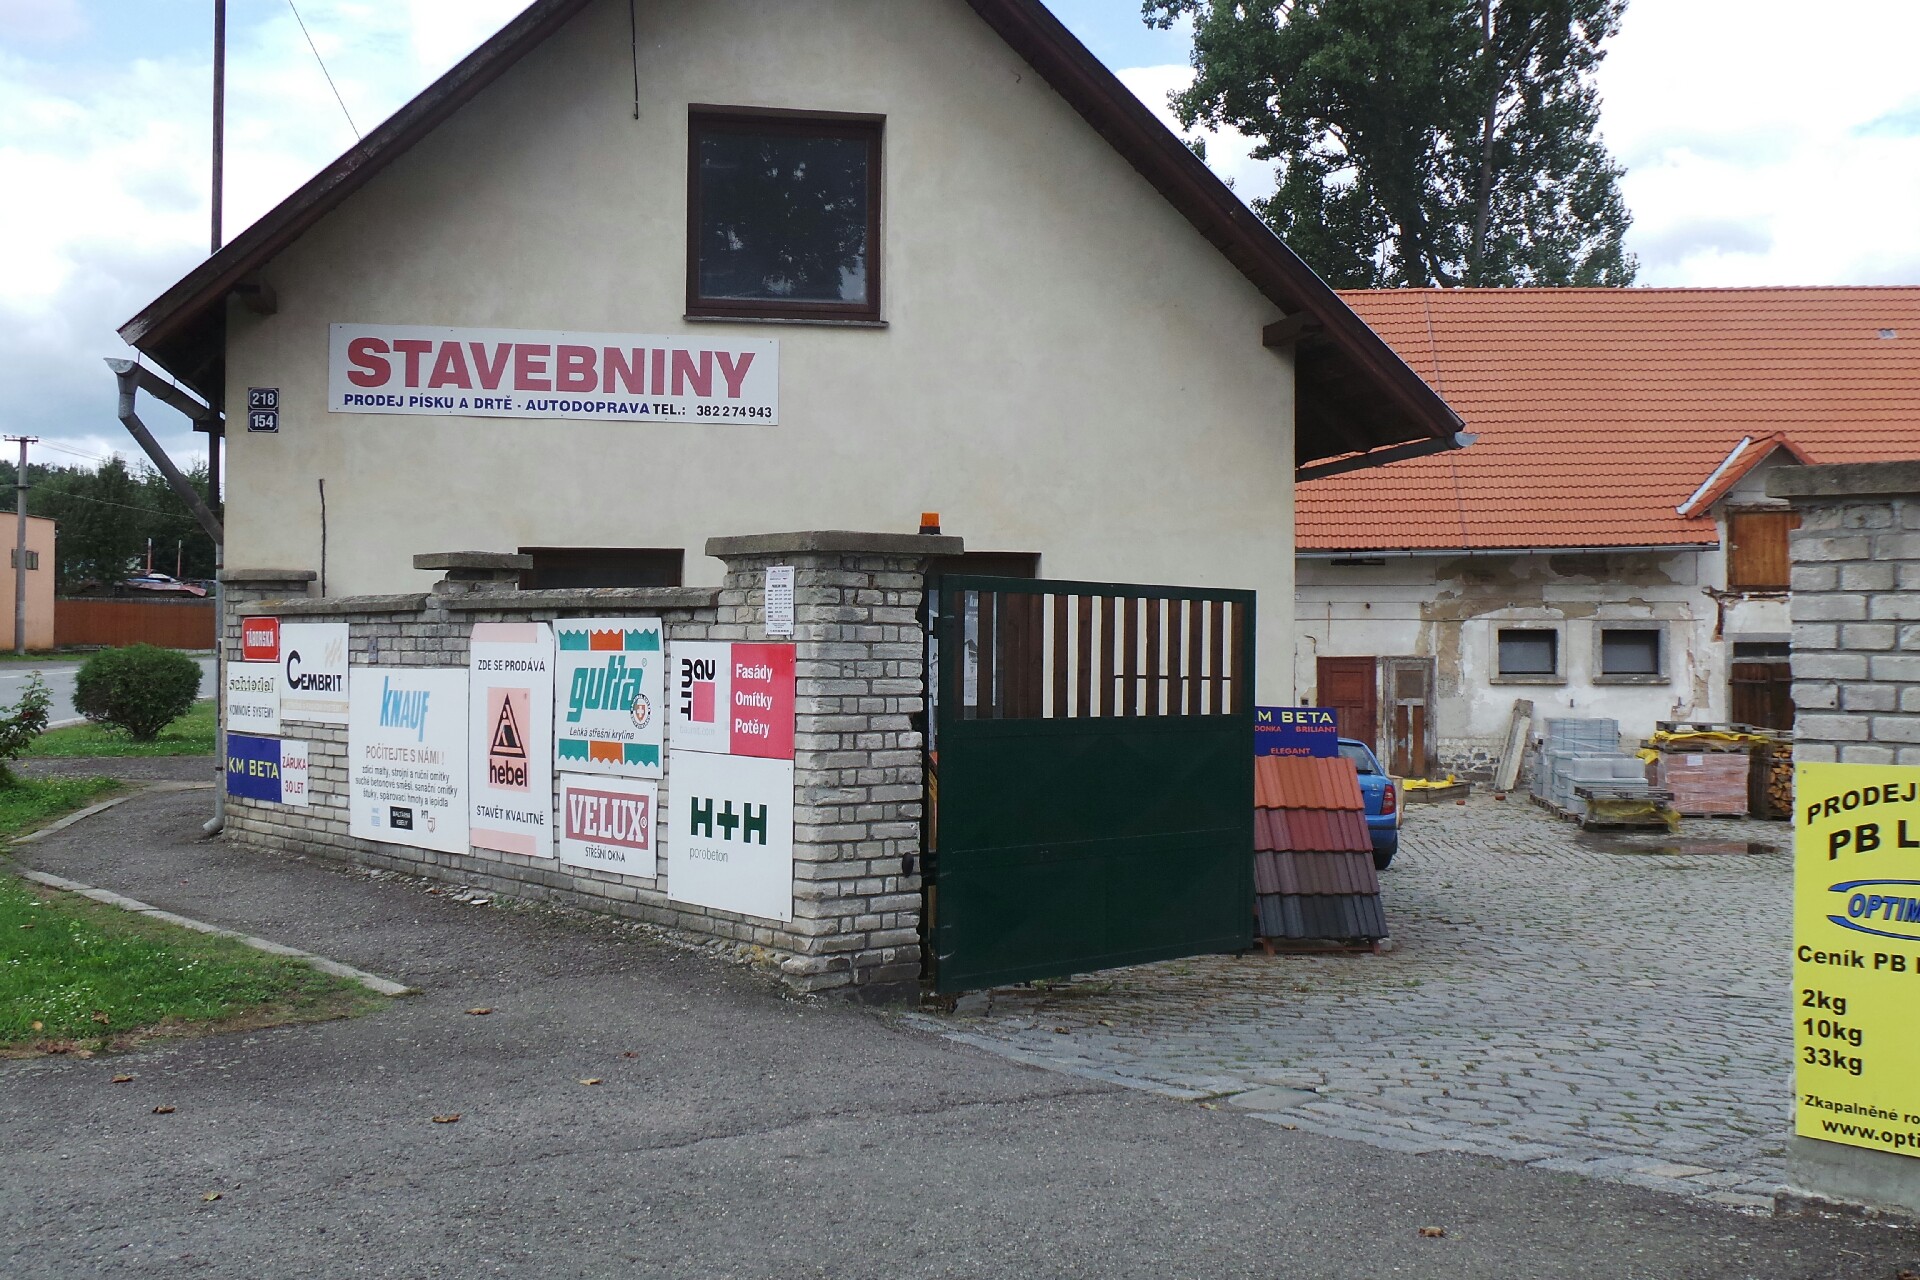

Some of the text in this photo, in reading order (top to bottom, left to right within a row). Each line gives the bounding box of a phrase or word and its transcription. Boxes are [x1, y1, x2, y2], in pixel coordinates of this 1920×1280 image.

[347, 337, 756, 399] STAVEBNINY
[252, 392, 275, 405] 218
[343, 393, 404, 408] PRODEJ
[409, 393, 454, 409] PÍSKU
[459, 397, 469, 409] A
[474, 394, 513, 410] DRTĚ
[525, 399, 650, 414] AUTODOPRAVA
[653, 403, 686, 416] TEL.:
[252, 414, 274, 428] 154
[246, 628, 274, 647] TÁBORSKÁ
[477, 656, 546, 673] ZDE SE PRODÁVÁ
[735, 663, 773, 683] Fasády
[229, 676, 275, 693] schiedel
[566, 655, 644, 722] gutta
[735, 690, 773, 711] Omítky
[734, 718, 770, 739] Potěry
[1257, 710, 1334, 724] M BETA
[1295, 725, 1337, 733] BRILIANT
[282, 752, 307, 771] ZÁRUKA
[365, 742, 409, 762] POČÍTEJTE
[410, 748, 416, 762] S
[417, 746, 440, 765] NÁMI
[1270, 747, 1311, 755] ELEGANT
[228, 756, 280, 780] KM BETA
[489, 758, 528, 788] hebel
[284, 780, 304, 795] 30 LET
[1807, 782, 1918, 826] PRODEJ
[505, 809, 545, 826] KVALITNĚ
[569, 794, 645, 843] VELUX
[690, 796, 768, 846] H+H
[1829, 819, 1920, 861] PB L
[584, 845, 626, 863] STŘEŠNÍ OKNA
[689, 847, 729, 863] porobeton
[1847, 892, 1920, 924] OPTIM
[1797, 944, 1866, 969] Ceník
[1873, 952, 1906, 972] PB
[1802, 988, 1847, 1016] 2kg
[1802, 1017, 1863, 1047] 10kg
[1802, 1046, 1863, 1076] 33kg
[1804, 1094, 1920, 1125] Zkapalněné ro
[1821, 1119, 1920, 1149] www.opti
